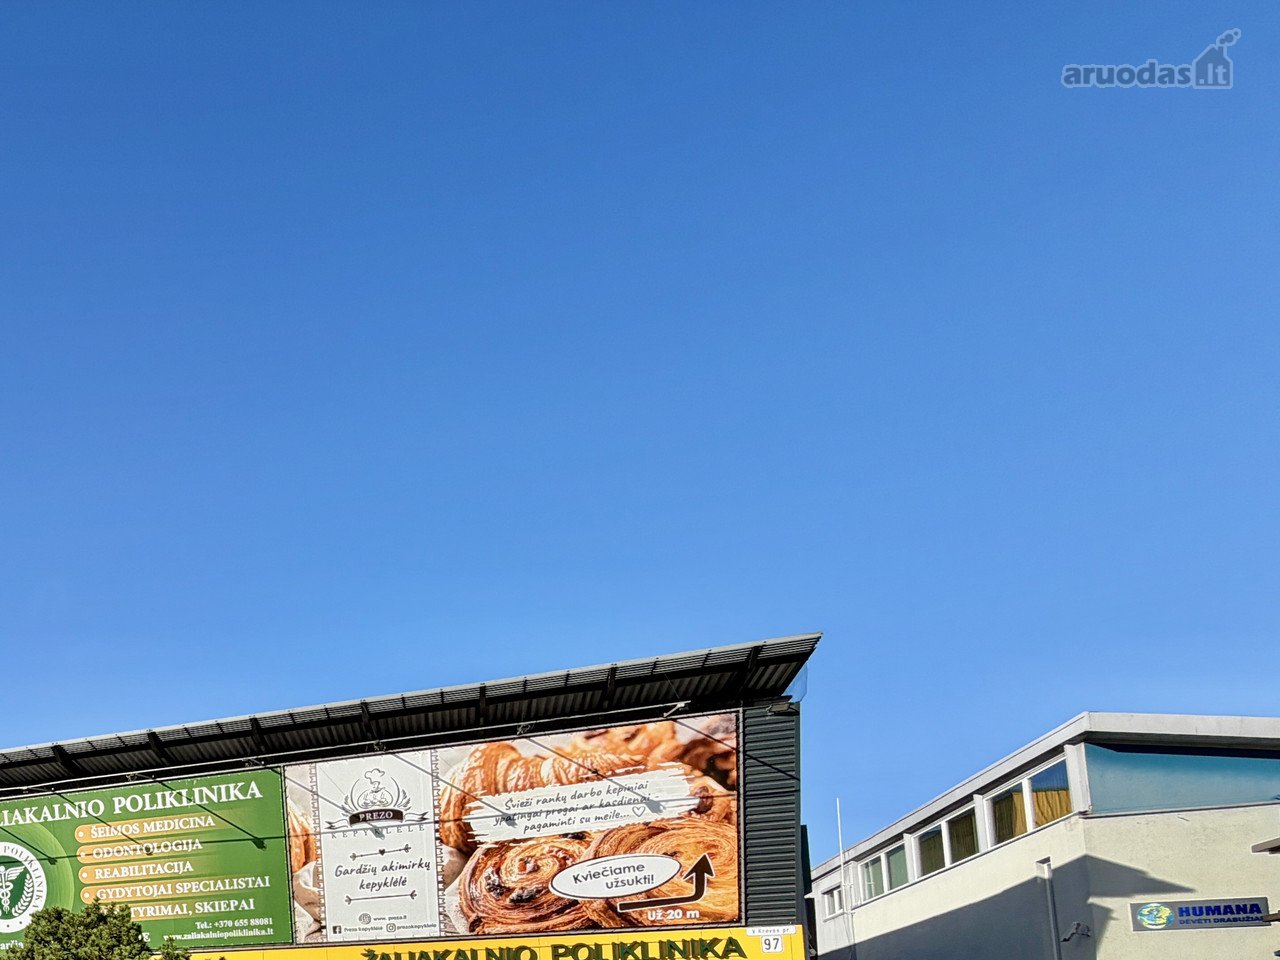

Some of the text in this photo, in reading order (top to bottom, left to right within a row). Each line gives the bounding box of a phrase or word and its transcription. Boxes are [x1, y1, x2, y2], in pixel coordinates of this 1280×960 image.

[112, 780, 263, 815] POLIKLINIKA
[504, 780, 649, 811] Švieži rankų darbo kepiniai
[358, 810, 394, 822] PREZO
[493, 808, 543, 827] ypatingai
[545, 804, 579, 820] progai
[582, 804, 594, 812] ar
[523, 817, 577, 834] pagaminti
[579, 816, 591, 824] su
[90, 815, 216, 839] ŠEIMOS MEDICINA
[91, 838, 204, 860] ODONTOLOGIJA
[94, 861, 195, 881] REABILITACIJA
[334, 857, 432, 878] Gardžių akimirkų
[572, 861, 646, 886] Kviečiame
[96, 876, 271, 901] GYDYTOJAI SPECIALISTAI
[359, 876, 408, 891] kepyklėlė
[605, 874, 656, 891] užsukti!
[130, 903, 193, 918] TYRIMAI,
[195, 898, 256, 914] SKIEPAI
[647, 906, 700, 922] Už 20 m
[1177, 902, 1263, 918] HUMANA
[764, 937, 780, 951] 97
